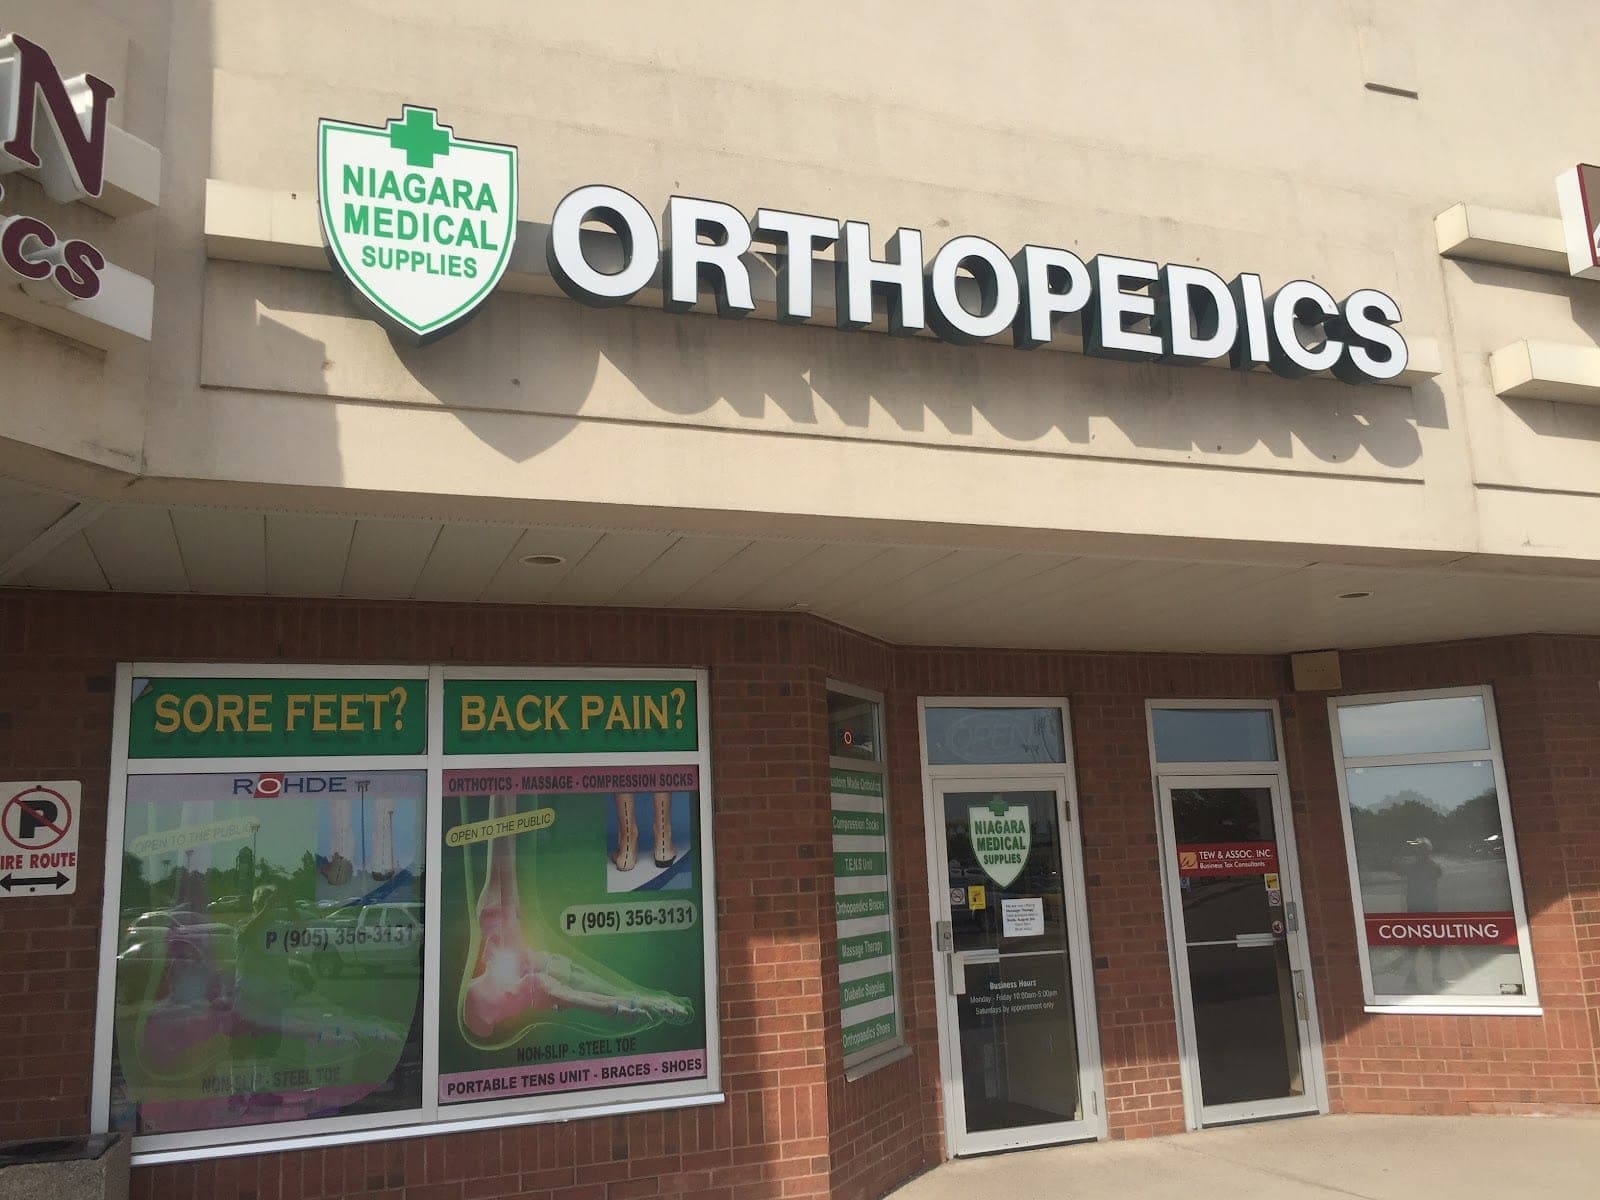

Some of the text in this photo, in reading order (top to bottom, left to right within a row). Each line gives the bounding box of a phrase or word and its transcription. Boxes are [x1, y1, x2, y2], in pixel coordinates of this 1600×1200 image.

[343, 164, 498, 213] NIAGARA
[344, 203, 498, 251] MEDICAL
[362, 245, 478, 279] SUPPLIES
[548, 184, 1409, 382] ORTHOPEDICS
[154, 687, 408, 734] SORE FEET?
[460, 687, 686, 732] BACK PAIN?
[233, 775, 347, 796] ROHDE
[448, 777, 512, 792] ORTHOTICS
[522, 775, 573, 790] MASSAGE
[582, 774, 656, 789] COMPRESSION
[659, 773, 693, 787] SOCKS
[451, 813, 551, 844] OPEN TO THE PUBLIC
[832, 816, 880, 832] Compression Socks
[974, 820, 1026, 835] NIAGARA
[170, 834, 186, 846] TO
[977, 836, 1026, 851] MEDICAL
[30, 852, 76, 869] ROUTE
[983, 853, 1022, 865] SUPPLIES
[1199, 851, 1215, 860] TEW
[1217, 851, 1224, 859] &
[1200, 861, 1266, 870] Business Tax Consultants
[868, 898, 885, 912] Braces
[566, 906, 693, 933] P (905) 356-3131
[1378, 923, 1500, 939] CONSULTING
[265, 931, 278, 949] P
[284, 928, 329, 952] (905)
[842, 940, 883, 958] Massage Therapy
[989, 981, 1017, 990] Business
[970, 995, 991, 1003] Monday
[996, 993, 1012, 1002] Friday
[1011, 1003, 1042, 1013] appointment
[517, 1043, 568, 1061] NON-SLIP
[578, 1039, 612, 1056] STEEL
[616, 1037, 636, 1053] TOE
[273, 1069, 311, 1086] STEEL
[447, 1076, 517, 1095] PORTABLE
[521, 1071, 555, 1088] TENS
[559, 1068, 590, 1083] UNIT
[601, 1063, 651, 1080] BRACES
[661, 1058, 702, 1074] SHOES
